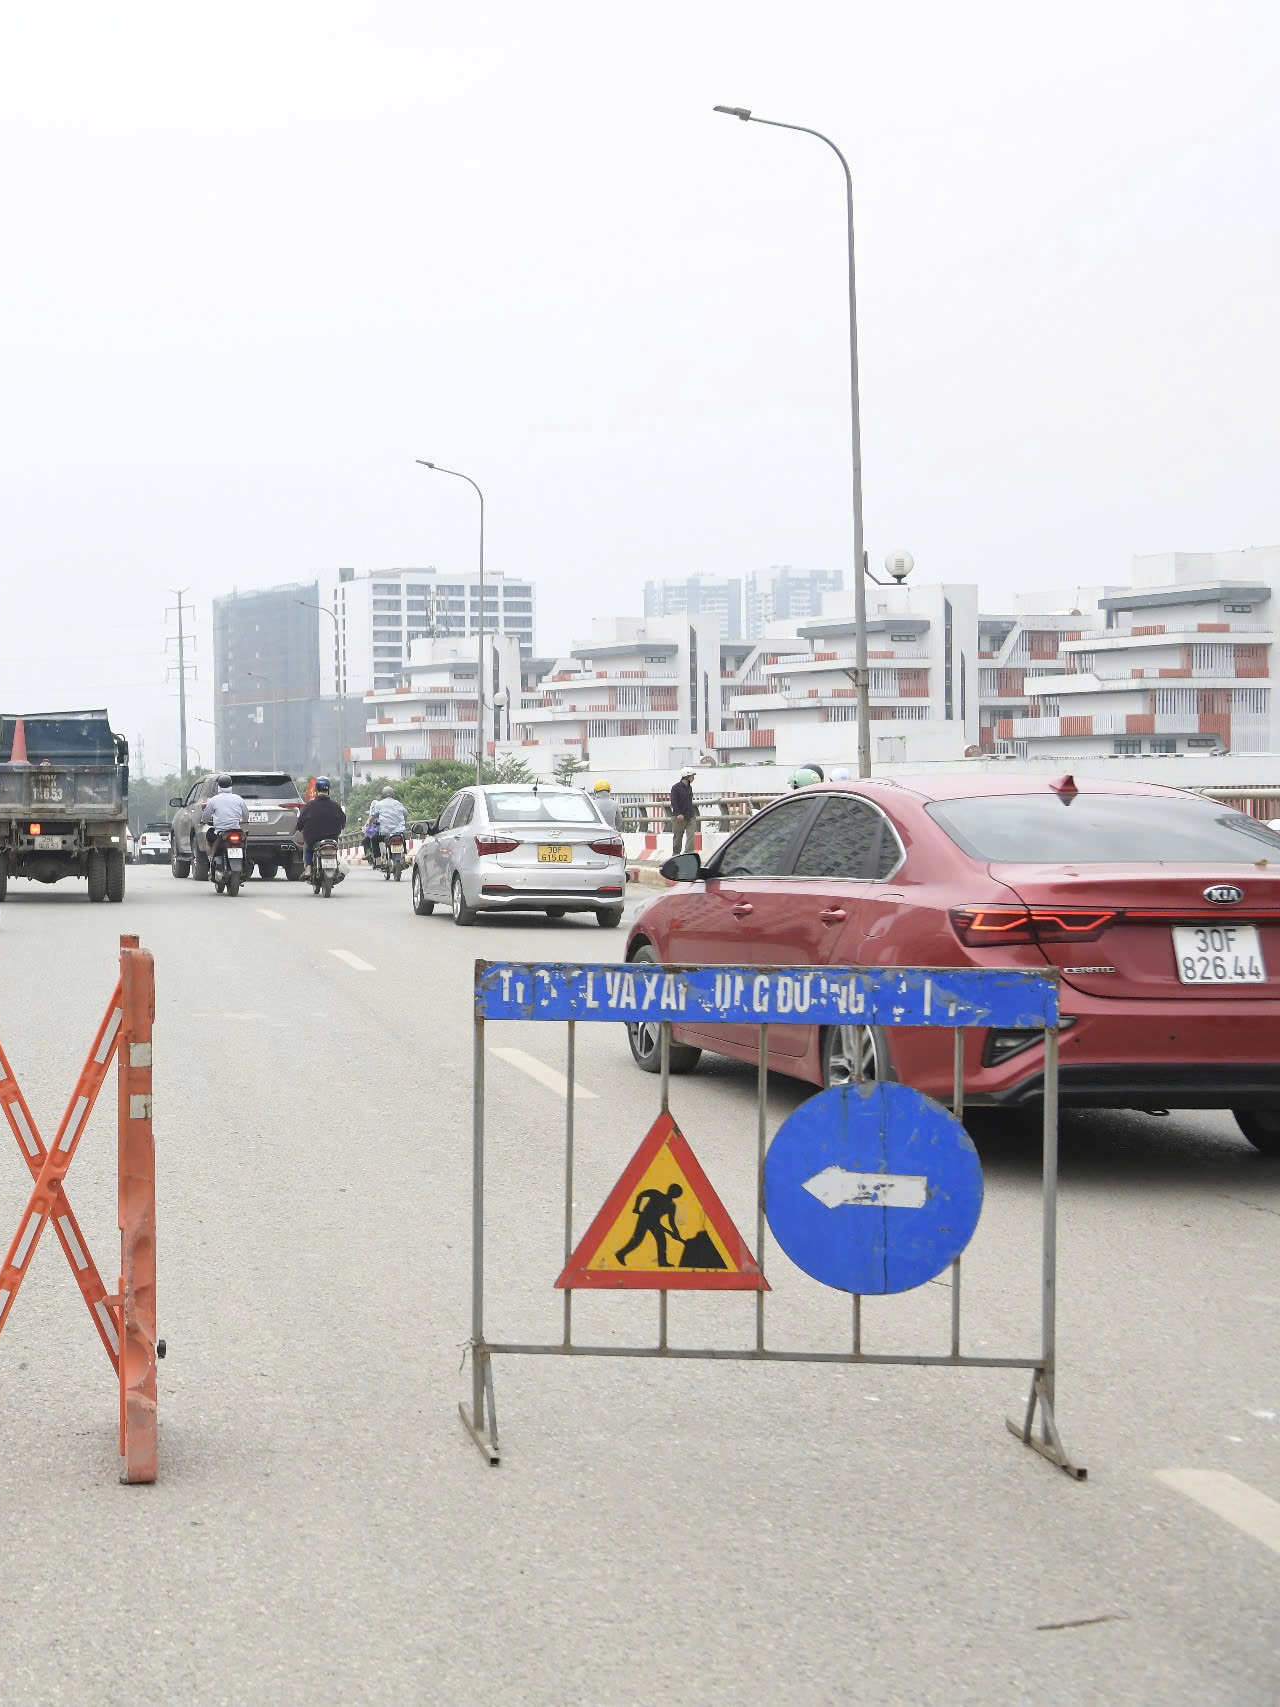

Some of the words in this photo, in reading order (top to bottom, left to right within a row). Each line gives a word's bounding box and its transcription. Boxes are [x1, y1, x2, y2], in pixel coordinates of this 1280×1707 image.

[547, 846, 562, 854] 30F
[541, 853, 569, 862] 615.02
[1211, 889, 1238, 901] KIA
[1194, 928, 1236, 953] 30F
[1182, 955, 1261, 981] 826.44
